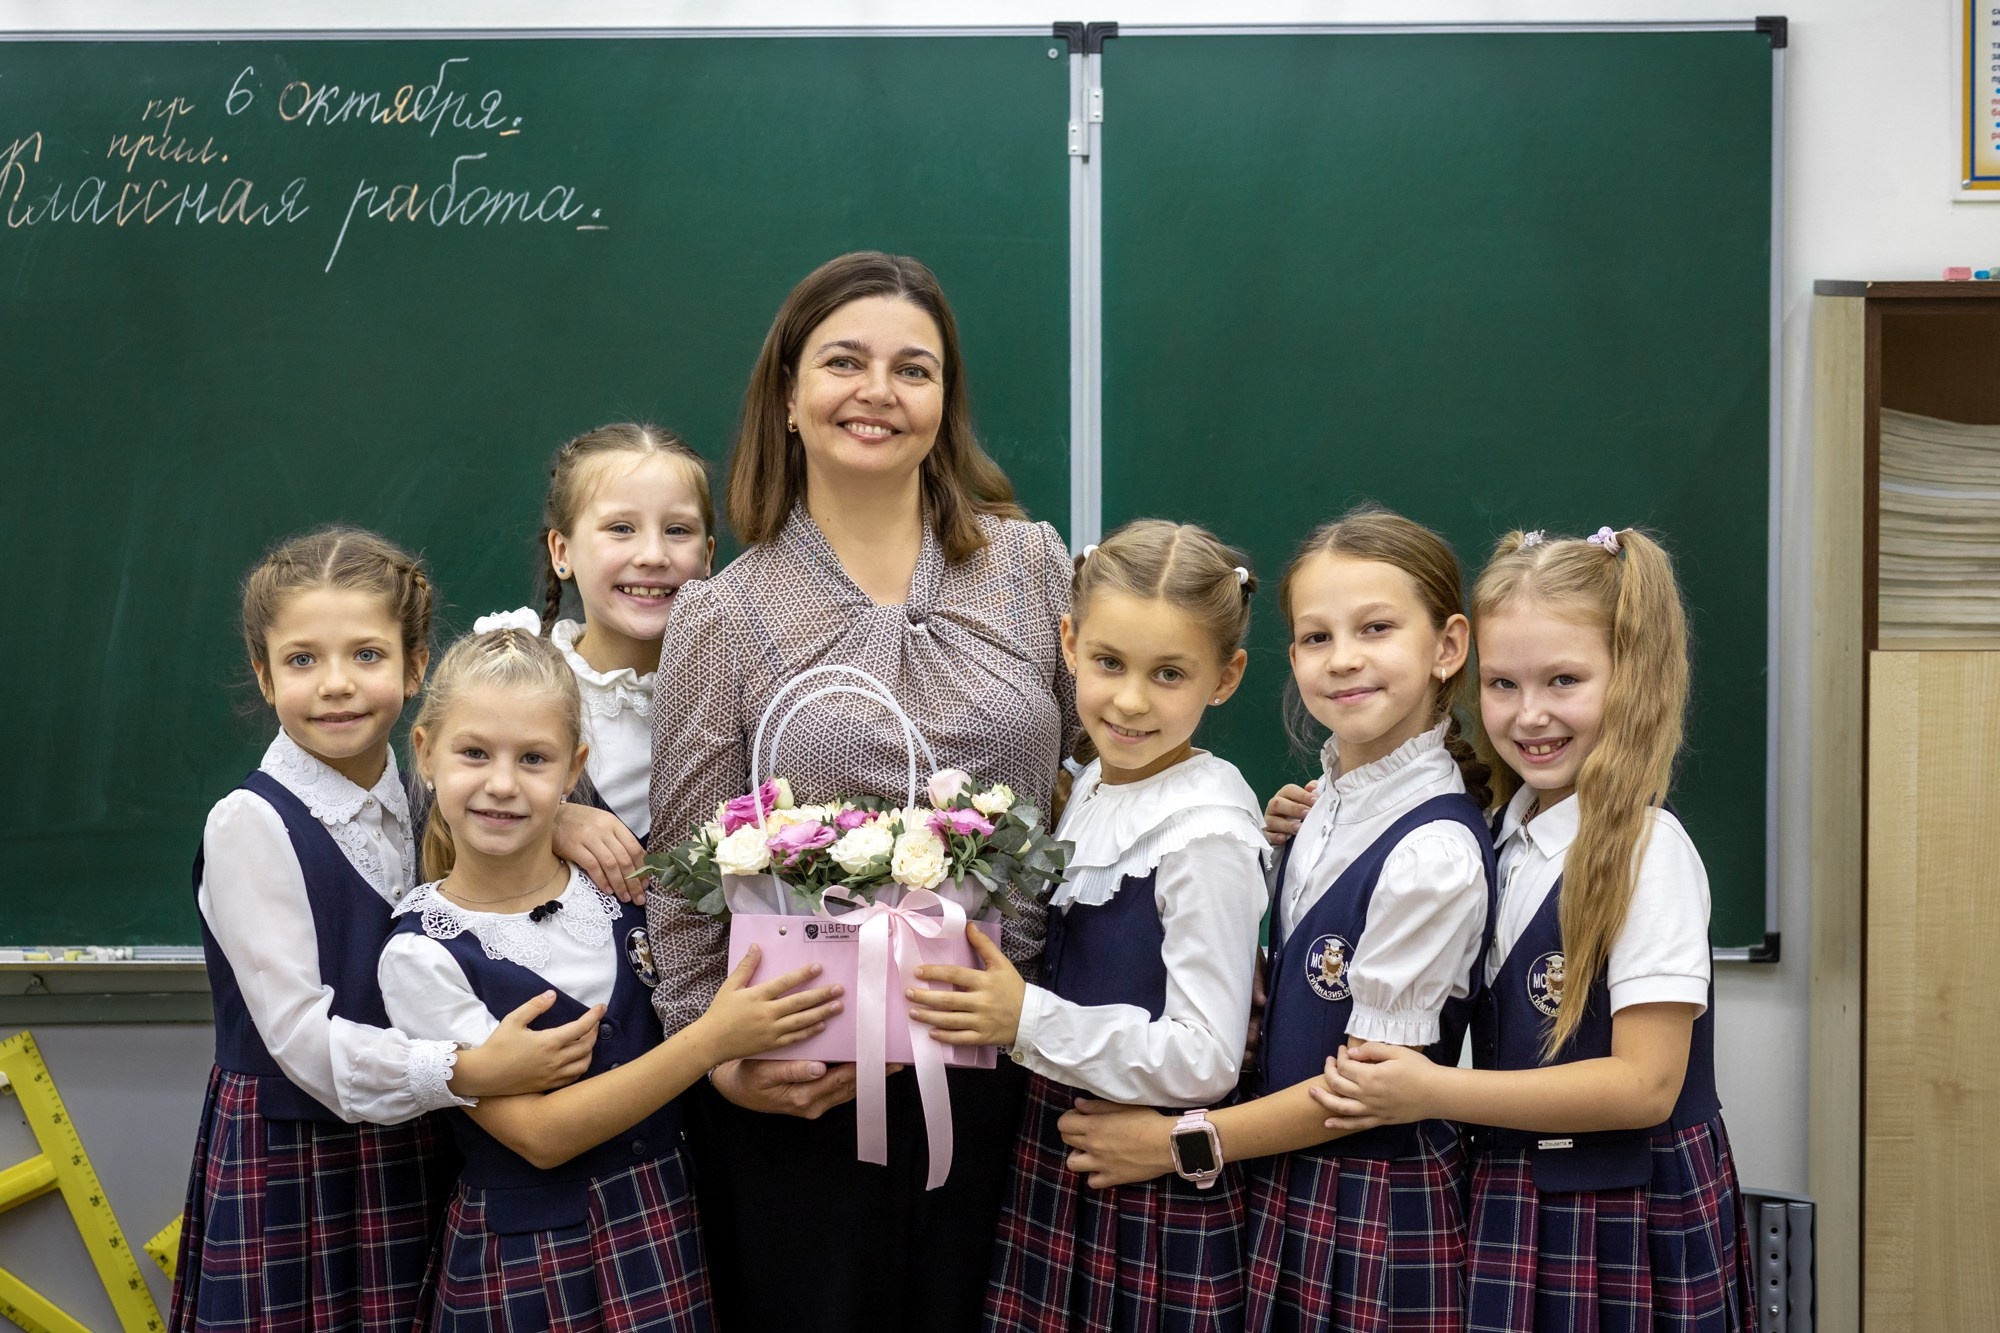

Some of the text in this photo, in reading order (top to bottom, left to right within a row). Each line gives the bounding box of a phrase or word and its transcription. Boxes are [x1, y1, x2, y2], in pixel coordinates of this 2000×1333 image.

[225, 65, 255, 116] 6
[0, 131, 604, 273] Классная работа.
[34, 1074, 43, 1083] 5
[52, 1112, 62, 1125] 10
[71, 1153, 82, 1167] 15
[90, 1195, 100, 1207] 20
[109, 1236, 119, 1249] 25
